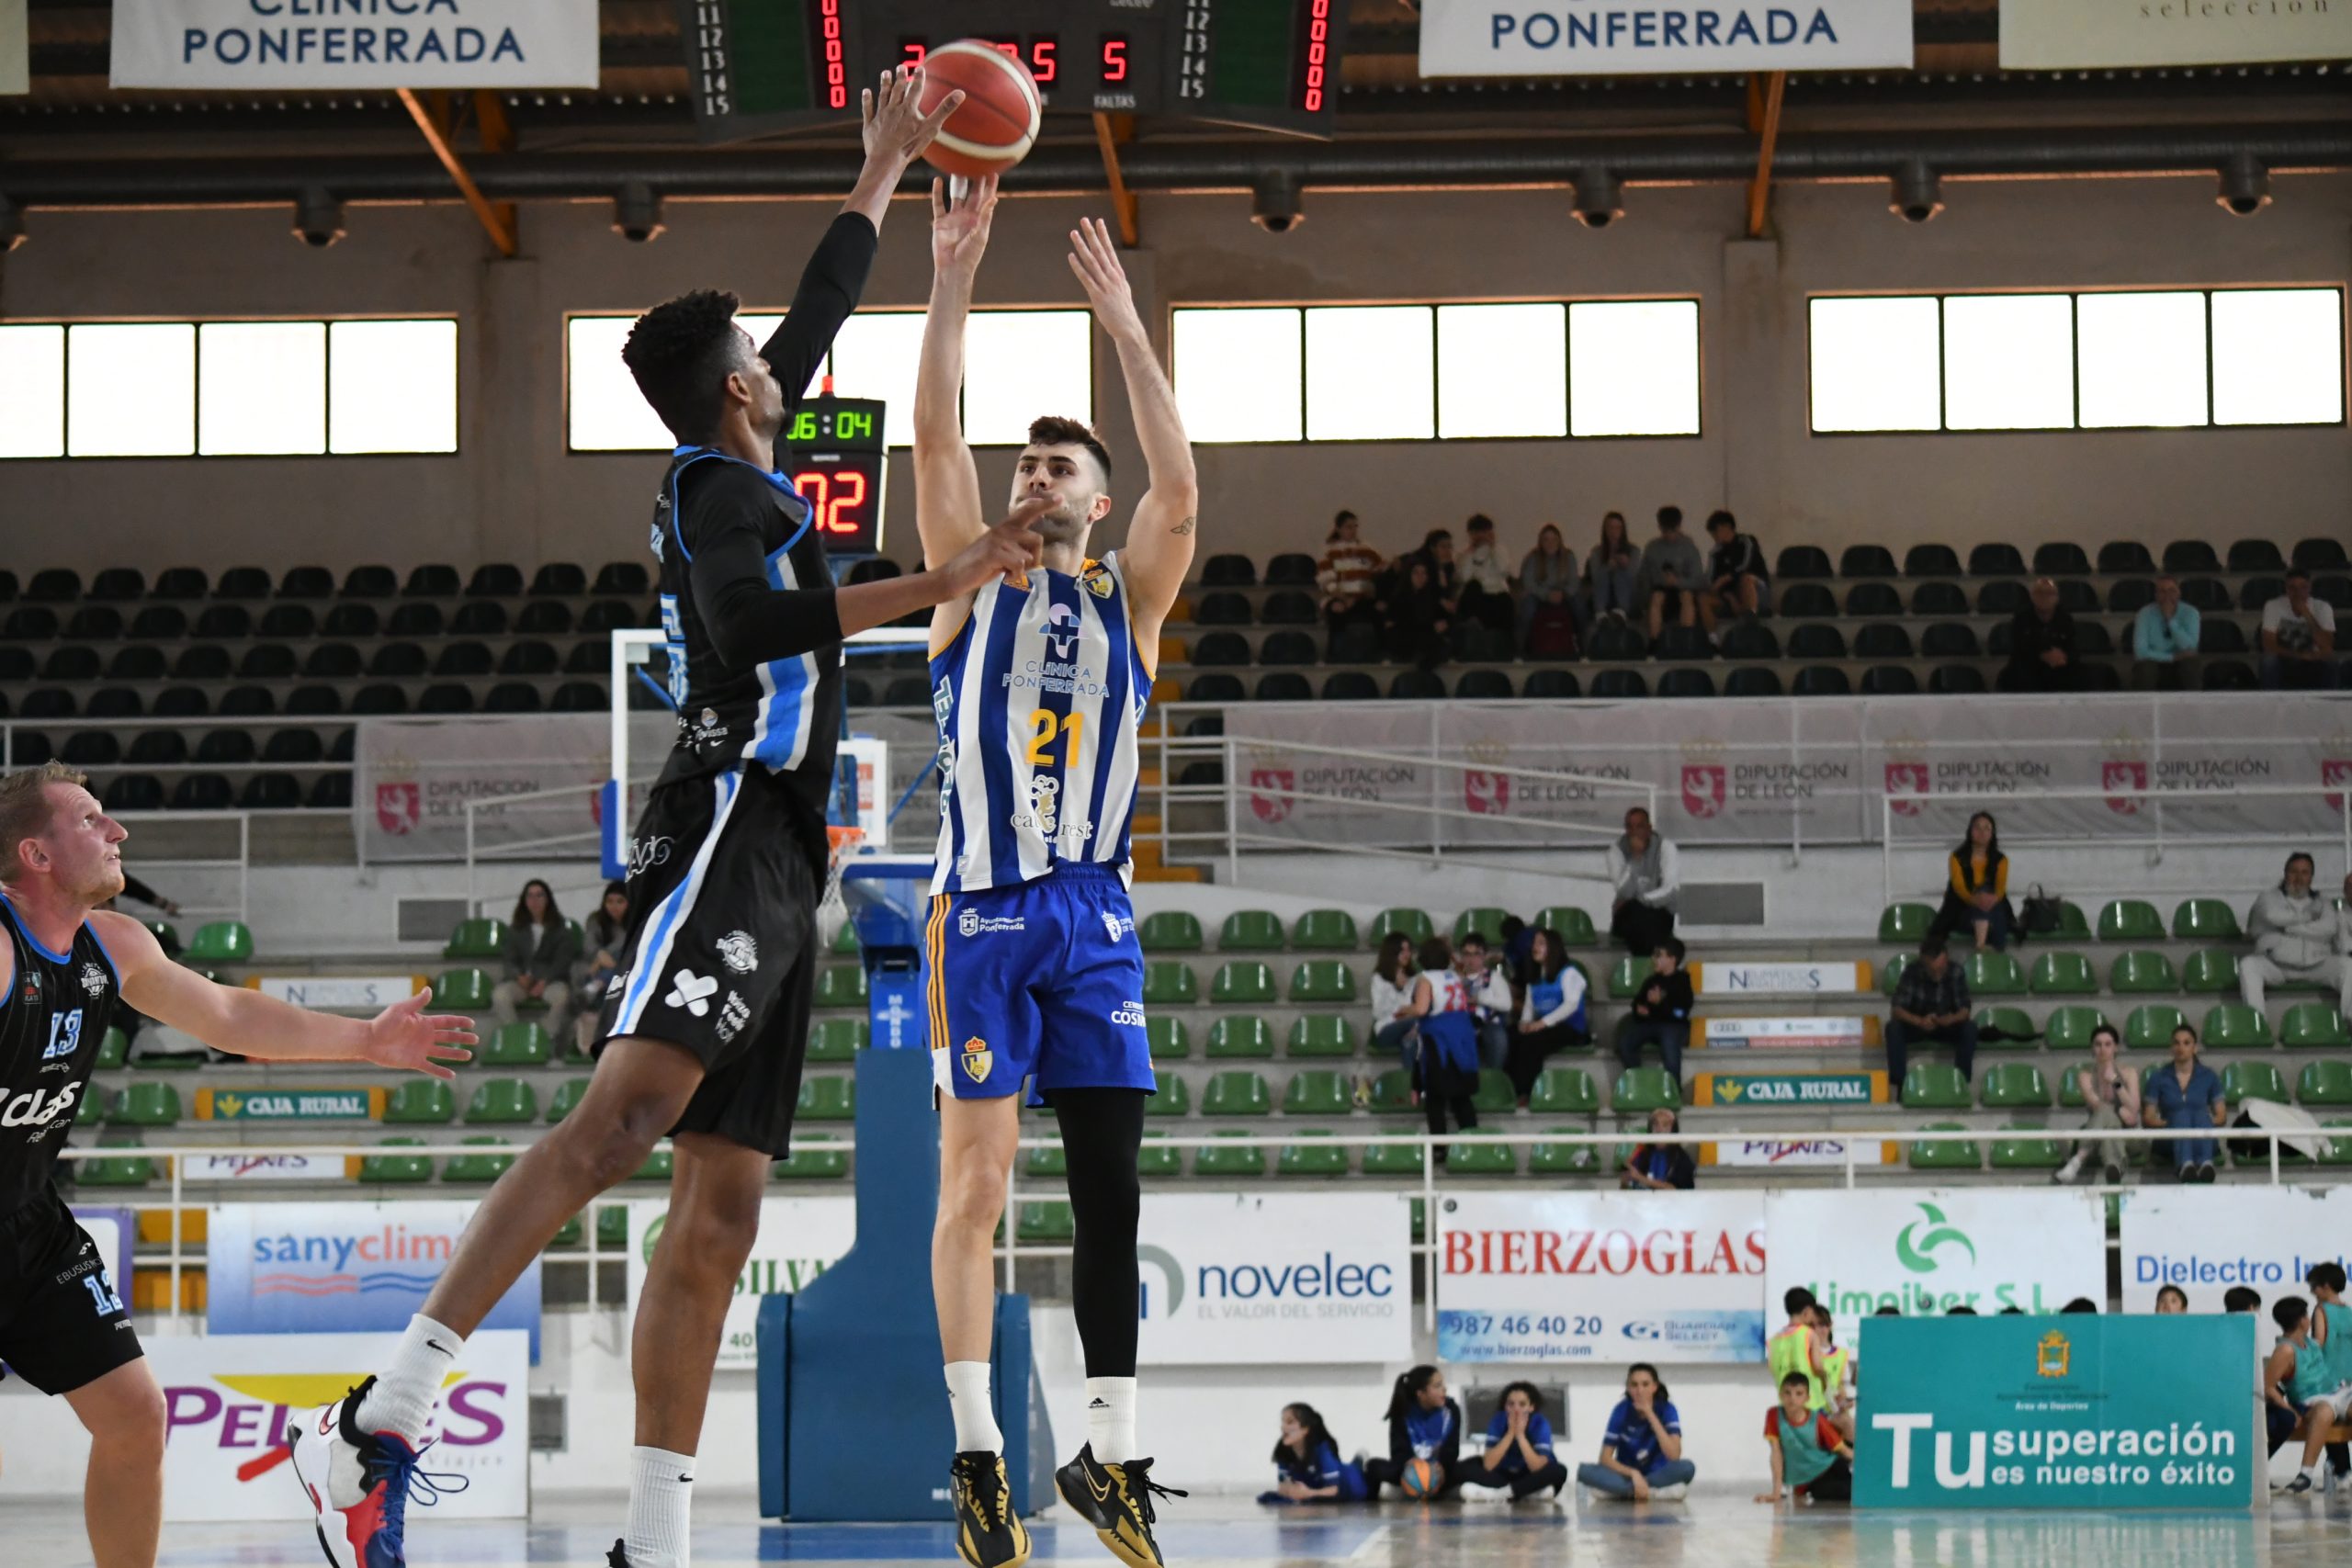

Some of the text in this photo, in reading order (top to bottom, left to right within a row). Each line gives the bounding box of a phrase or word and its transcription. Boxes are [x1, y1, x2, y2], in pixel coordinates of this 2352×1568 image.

[1185, 10, 1210, 30] 12
[1491, 8, 1838, 50] PONFERRADA
[184, 28, 526, 64] PONFERRADA
[700, 28, 723, 48] 12
[1183, 32, 1207, 53] 13
[702, 51, 726, 70] 13
[1104, 41, 1126, 80] 5
[1182, 56, 1205, 76] 14
[704, 73, 728, 93] 14
[1180, 78, 1204, 98] 15
[706, 96, 729, 115] 15
[1001, 672, 1110, 698] PONFERRADA
[1025, 708, 1086, 770] 21
[979, 922, 1025, 932] Ponferrada
[42, 1008, 83, 1059] 13
[1747, 1080, 1867, 1100] CAJA RURAL
[247, 1095, 366, 1116] CAJA RURAL
[254, 1224, 458, 1271] sanyclim
[1442, 1228, 1766, 1277] BIERZOGLAS
[1198, 1251, 1393, 1299] novelec
[2136, 1255, 2283, 1283] Dielectro
[1197, 1301, 1394, 1320] EL VALOR DEL SERVICIO
[1451, 1315, 1602, 1336] 987 46 40 20
[729, 1332, 753, 1348] 40
[1460, 1343, 1591, 1359] www.bierzoglas.com
[2037, 1402, 2048, 1411] de
[2050, 1402, 2089, 1412] Deportes
[1871, 1413, 2235, 1489] Tu superación
[1992, 1461, 2235, 1485] es nuestro éxito
